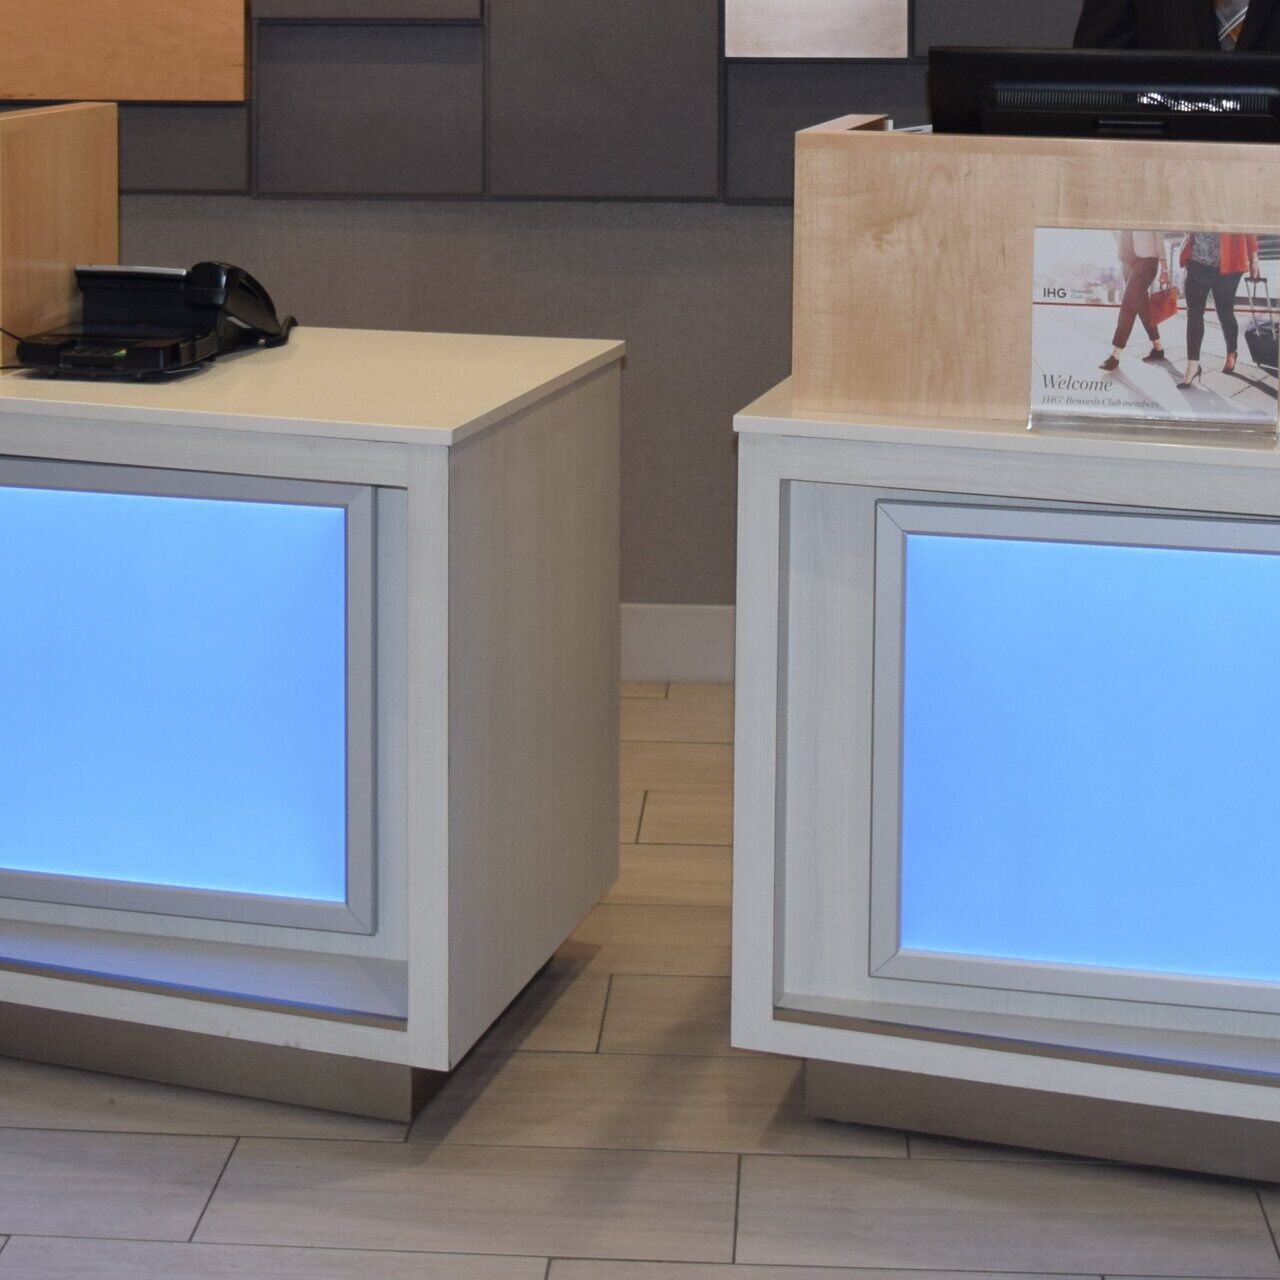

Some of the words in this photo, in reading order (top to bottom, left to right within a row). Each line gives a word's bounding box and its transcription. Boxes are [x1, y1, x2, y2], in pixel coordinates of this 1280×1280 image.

[1042, 287, 1068, 299] IHG
[1042, 373, 1113, 391] Welcome
[1066, 396, 1100, 407] Rewards
[1101, 398, 1122, 408] Club
